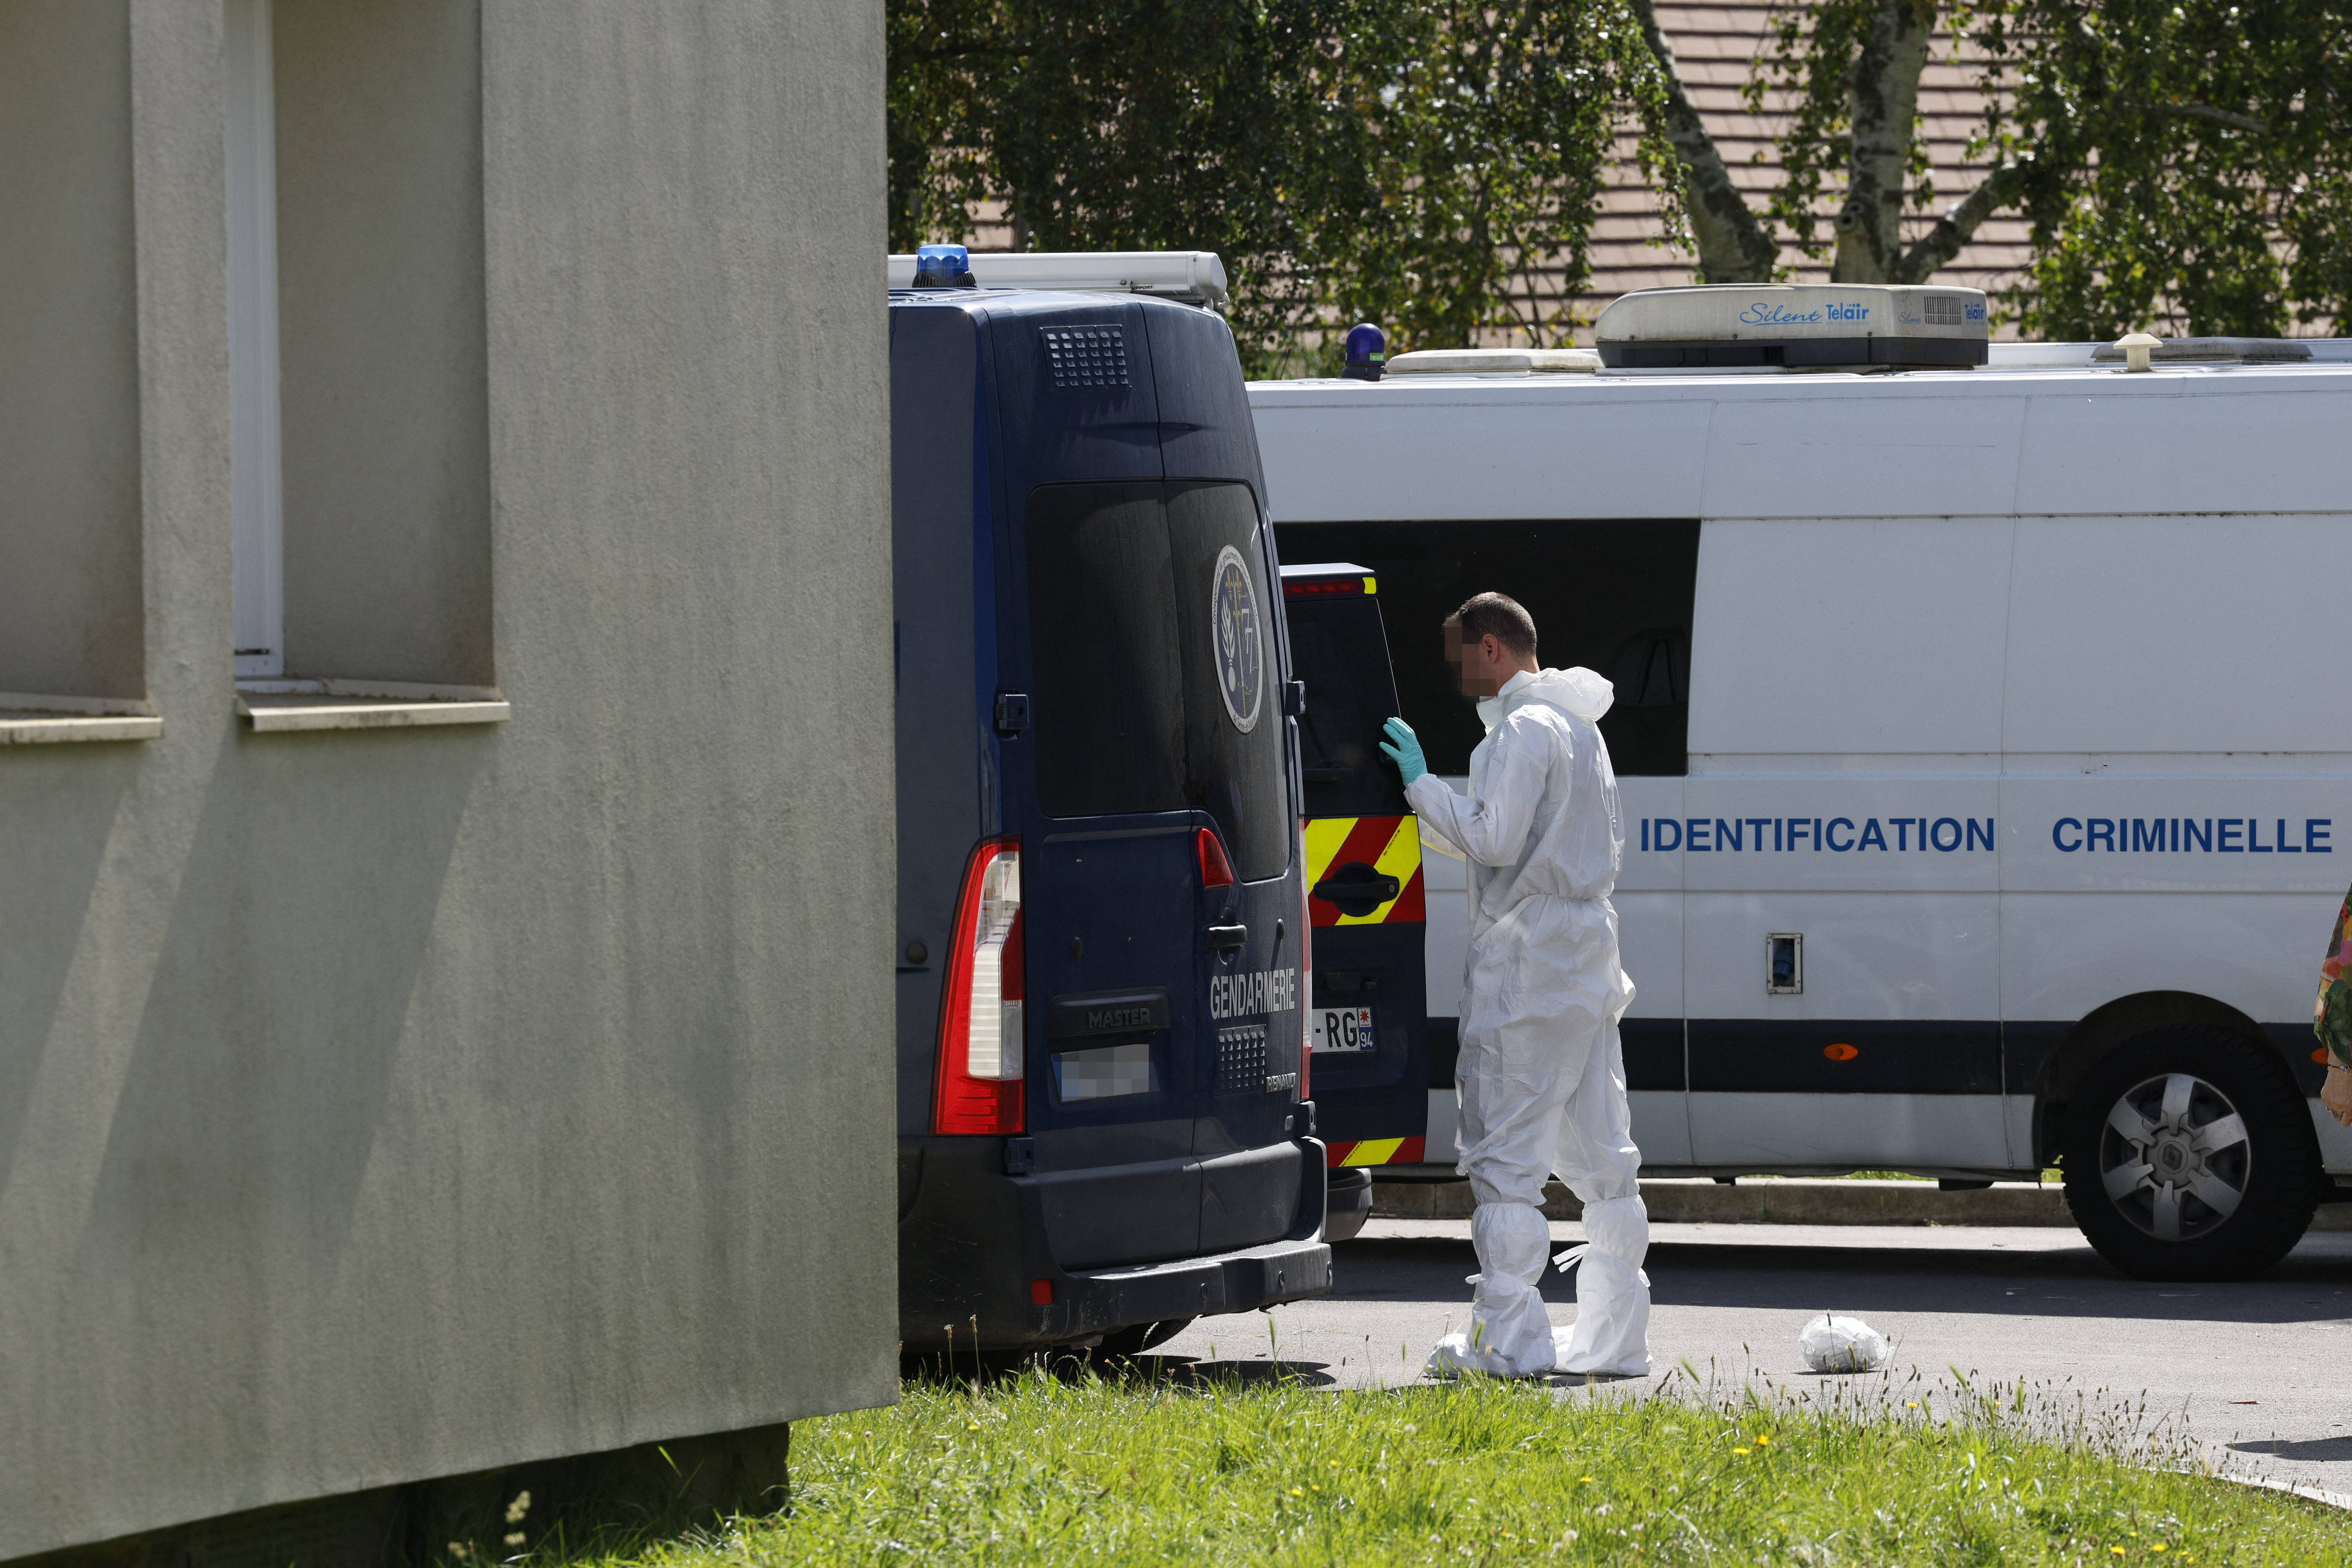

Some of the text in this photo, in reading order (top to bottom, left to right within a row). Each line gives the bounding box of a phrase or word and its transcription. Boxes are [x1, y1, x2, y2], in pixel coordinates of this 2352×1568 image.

[1739, 303, 1822, 324] Silent
[1218, 558, 1223, 571] de
[1223, 548, 1239, 568] gendarmerie
[1241, 608, 1252, 674] 77
[1233, 712, 1237, 724] de
[1641, 818, 2332, 852] IDENTIFICATION CRIMINELLE
[1211, 968, 1294, 1020] GENDARMERIE
[1088, 1008, 1150, 1028] MASTER
[1361, 1031, 1373, 1047] 94
[1266, 1073, 1296, 1093] RENAULT
